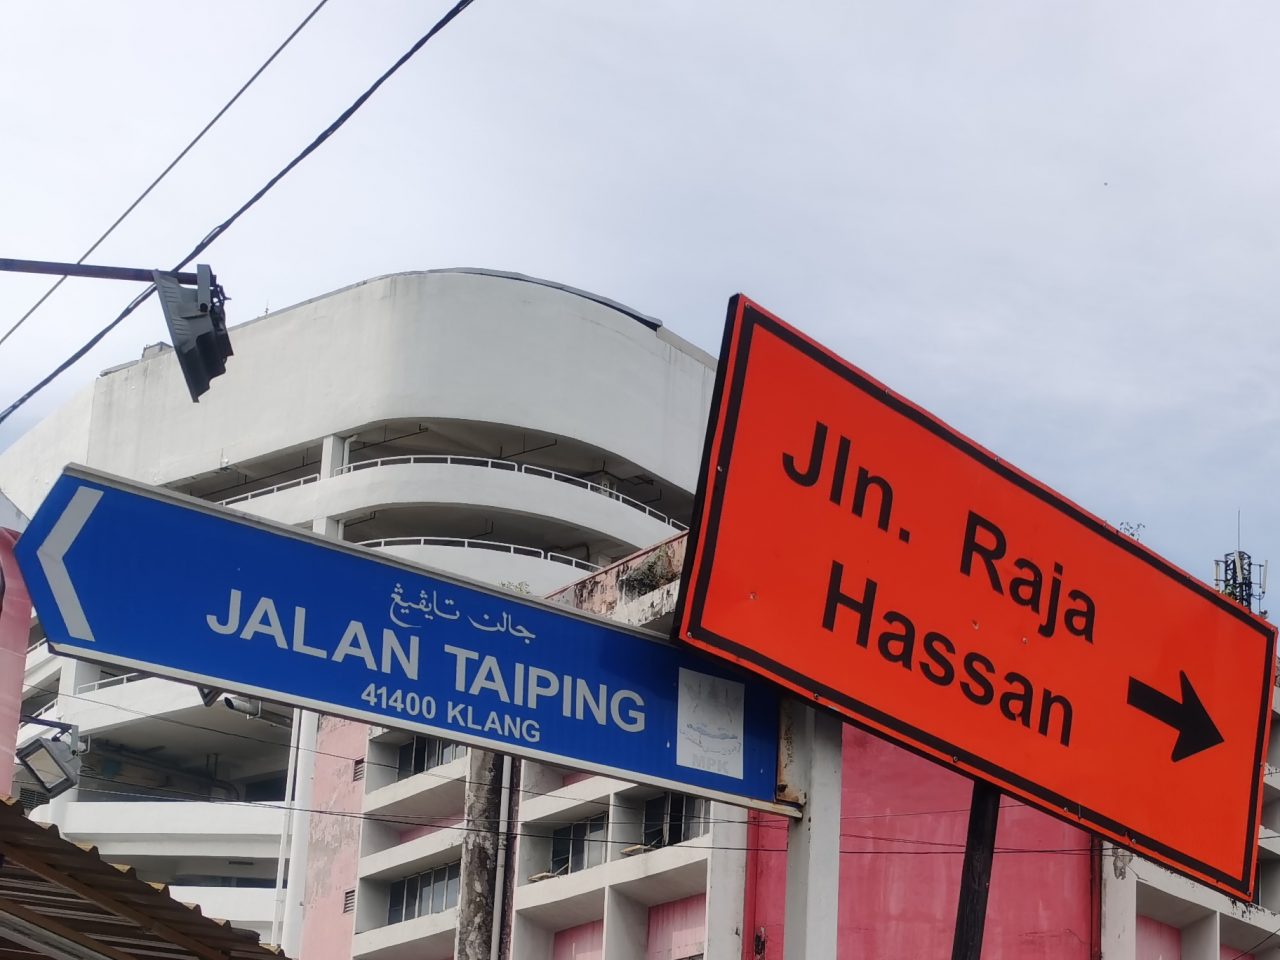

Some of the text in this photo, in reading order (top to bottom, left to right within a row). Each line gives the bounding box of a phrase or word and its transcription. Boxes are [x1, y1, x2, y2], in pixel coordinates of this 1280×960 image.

[782, 421, 1097, 644] Jln. Raja
[206, 589, 646, 733] JALAN TAIPING
[467, 611, 537, 644] جالن
[822, 561, 1075, 747] Hassan
[361, 683, 541, 743] 41400 KLANG
